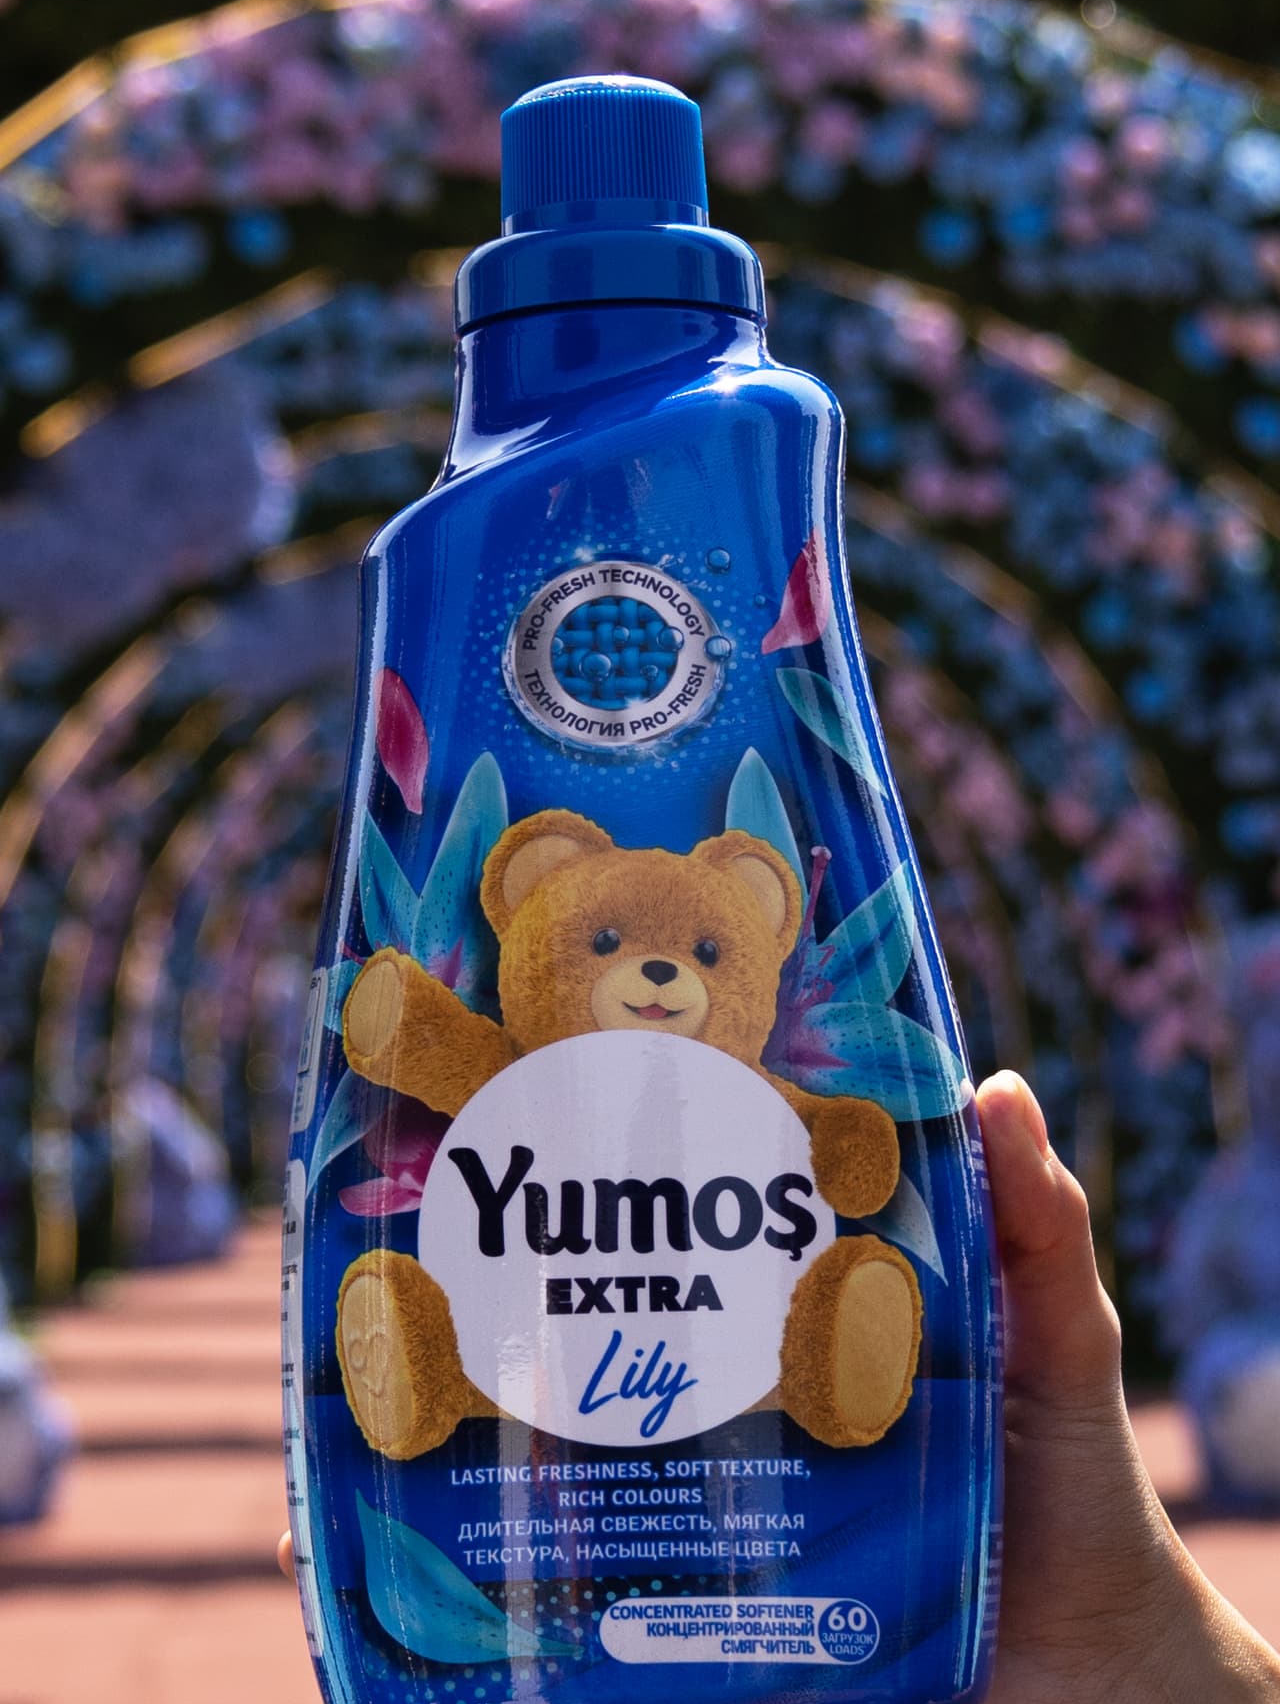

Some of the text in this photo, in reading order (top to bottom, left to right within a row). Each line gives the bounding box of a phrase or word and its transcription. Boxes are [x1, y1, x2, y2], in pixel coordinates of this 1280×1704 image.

[522, 568, 705, 651] PRO-FRESH TECHNOLOGY
[524, 663, 707, 737] ТЕХНОЛОГИЯ PRO-FRESH
[447, 1145, 818, 1262] Yumoş
[545, 1274, 724, 1315] EXTRA
[578, 1329, 699, 1439] Lily
[451, 1459, 812, 1486] LASTING FRESHNESS, SOFT TEXTURE,
[559, 1488, 703, 1507] RICH COLOURS
[457, 1513, 805, 1543] ДЛИТЕЛЬНАЯ СВЕЖЕСТЬ, МЯГКАЯ
[463, 1540, 802, 1566] ТЕКСТУРА, НАСЫЩЕННЫЕ ЦВЕТА
[609, 1603, 815, 1621] CONCENTRATED SOFTENER
[828, 1606, 868, 1632] 60
[646, 1619, 816, 1639] КОНЦЕНТРИРОВАННЫЙ
[720, 1639, 816, 1655] СМЯГЧИТЕЛЬ
